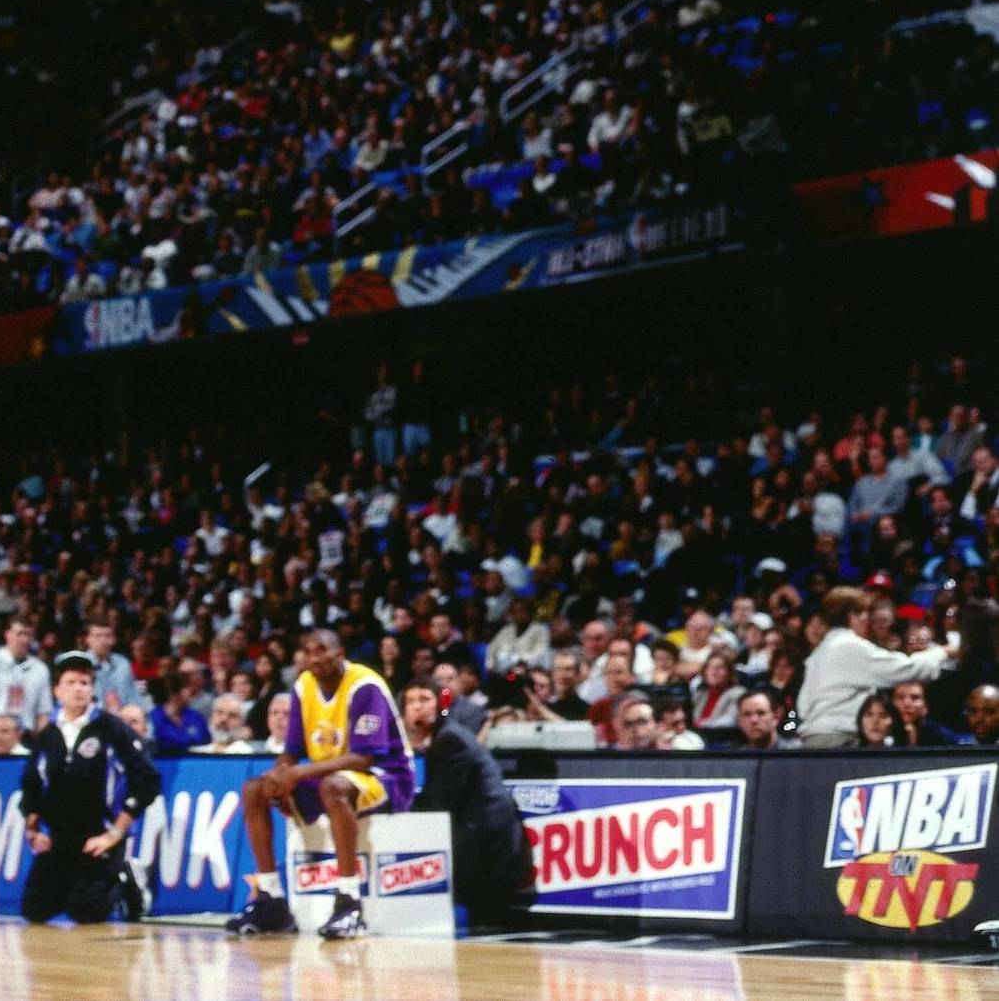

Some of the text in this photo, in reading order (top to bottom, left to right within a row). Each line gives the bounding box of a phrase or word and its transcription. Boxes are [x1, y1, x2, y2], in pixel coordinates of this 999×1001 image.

[98, 297, 154, 346] NBA
[860, 772, 984, 854] NBA
[298, 856, 363, 888] CRUN
[381, 857, 443, 890] CRUNCH
[842, 862, 980, 935] TNT
